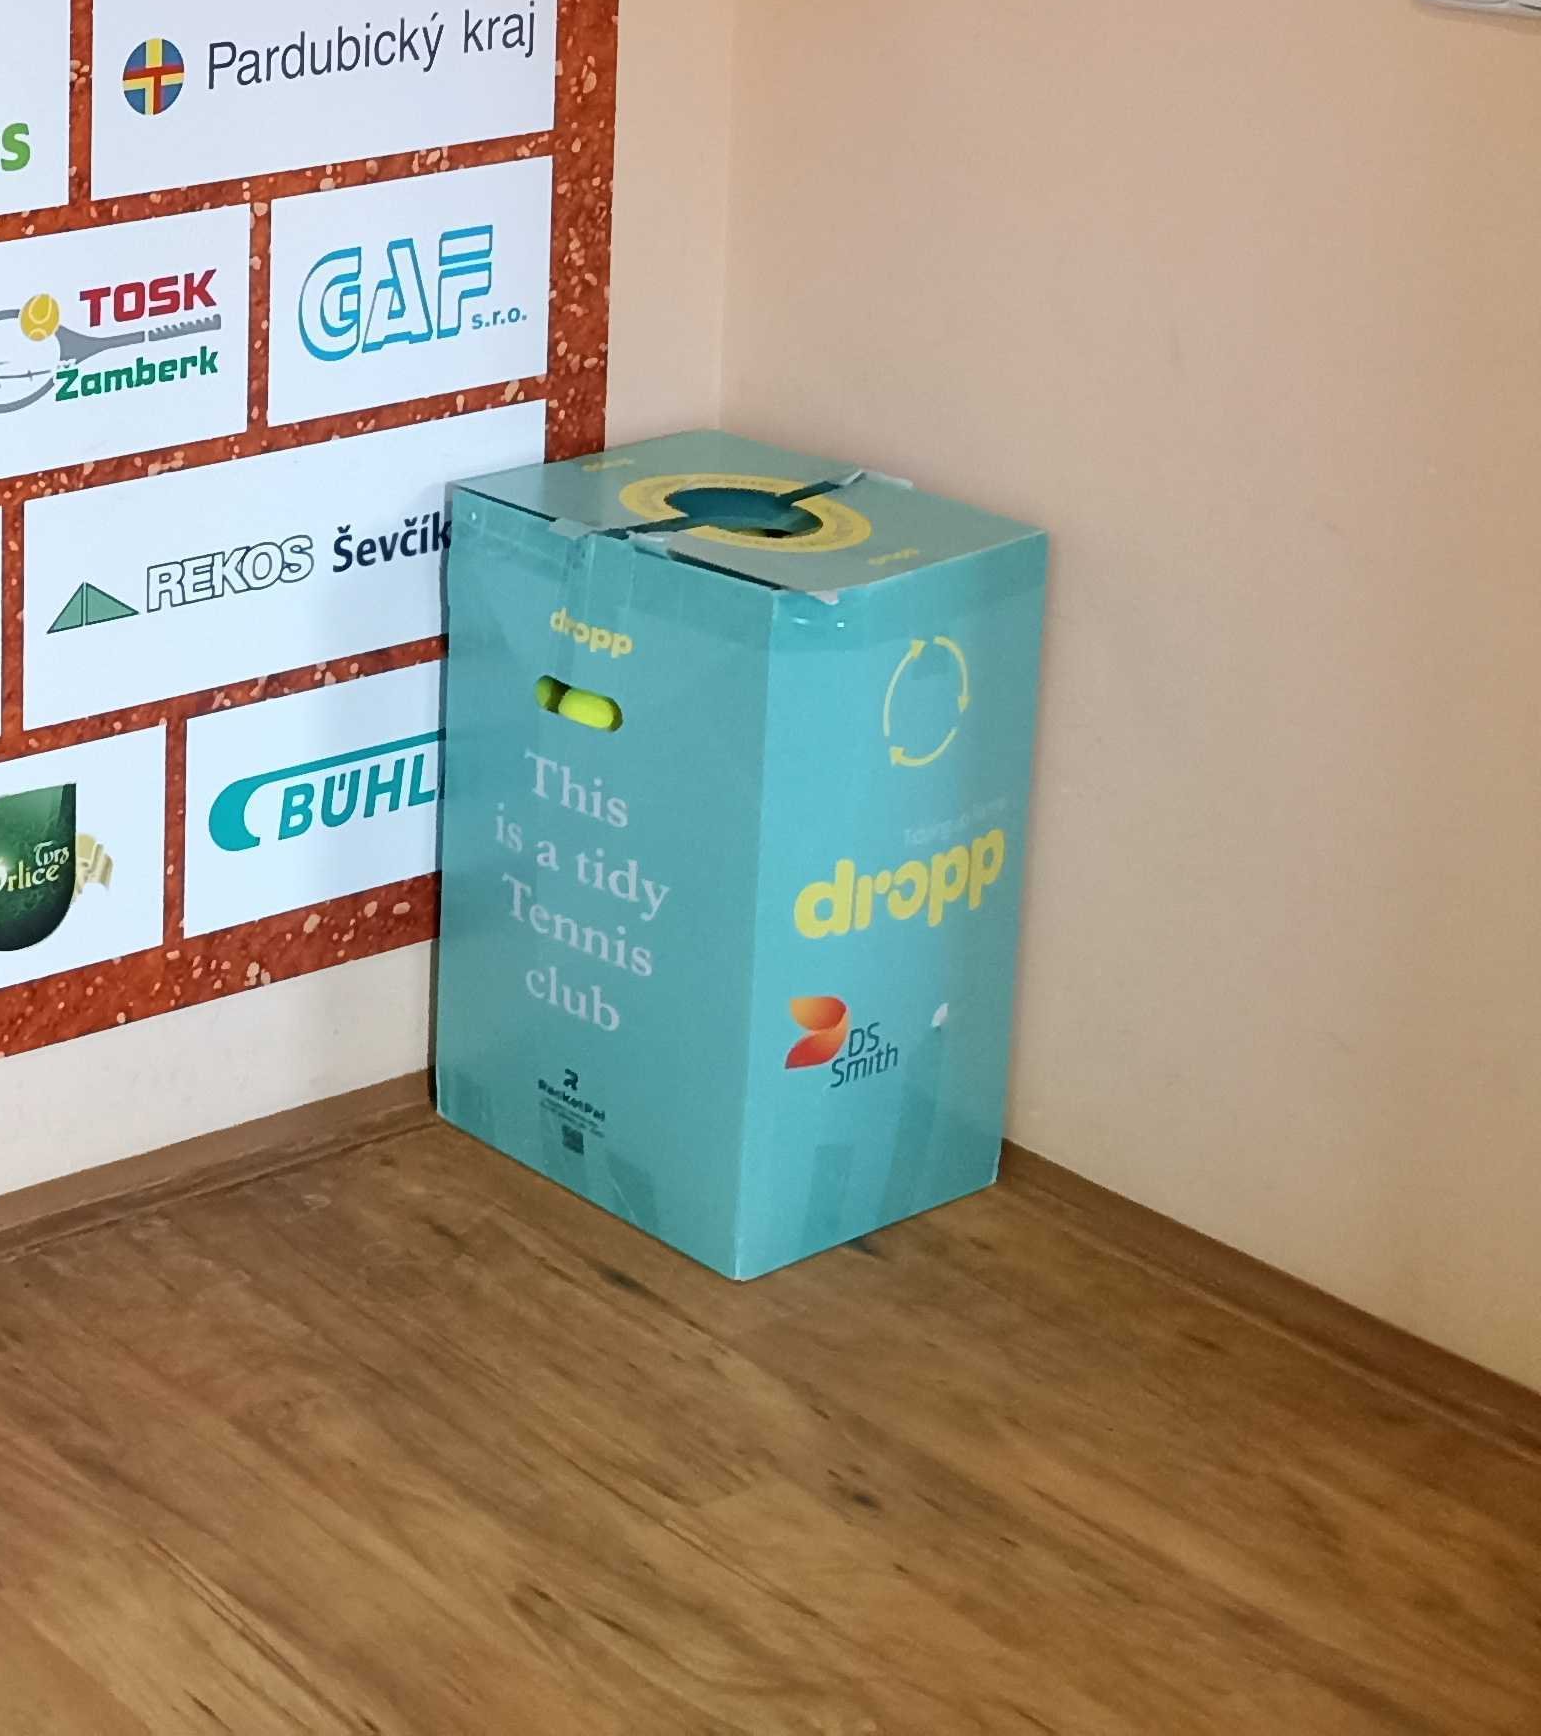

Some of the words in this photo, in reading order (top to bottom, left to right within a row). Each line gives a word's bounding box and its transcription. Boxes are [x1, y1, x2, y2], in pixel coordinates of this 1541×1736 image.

[207, 10, 445, 91] Pardubický
[462, 0, 537, 59] kraj
[79, 268, 217, 328] TOSK
[298, 224, 493, 362] GAF
[471, 306, 528, 331] s.r.o.
[54, 346, 219, 402] Žamberk
[146, 534, 314, 613] REKOS
[332, 511, 451, 574] Ševčík
[549, 607, 634, 659] dropp
[278, 752, 444, 841] BÜHL
[524, 748, 630, 829] This
[495, 802, 523, 853] is
[536, 839, 560, 872] a
[575, 847, 670, 922] tidy
[793, 827, 1006, 940] dropp
[501, 871, 654, 978] Tennis
[525, 966, 621, 1032] club
[848, 1021, 881, 1058] DS
[829, 1042, 899, 1089] Smith
